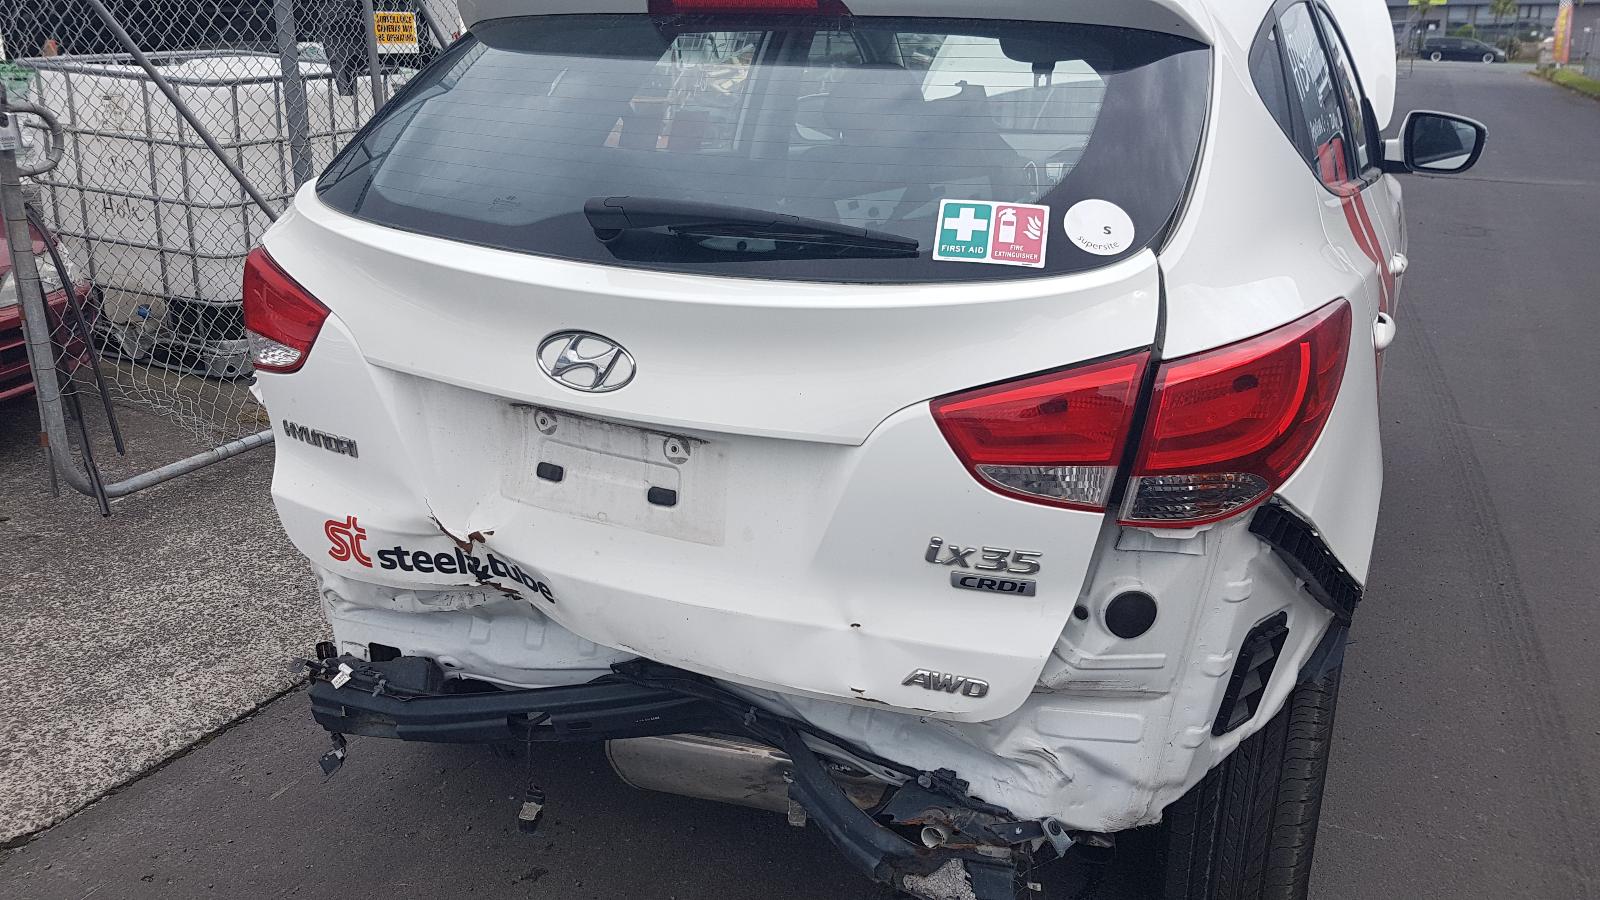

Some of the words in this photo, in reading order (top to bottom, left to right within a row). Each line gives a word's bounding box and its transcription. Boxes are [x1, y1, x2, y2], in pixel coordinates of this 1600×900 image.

[941, 244, 966, 253] FIRST
[968, 246, 984, 254] AID
[1009, 244, 1024, 252] FIRE
[1077, 234, 1120, 251] supersite
[994, 250, 1038, 260] EXTINGUISHER
[282, 419, 359, 459] HYUNDAI
[925, 536, 1044, 576] ix35
[959, 576, 1027, 594] CRDi
[902, 668, 990, 699] AWD
